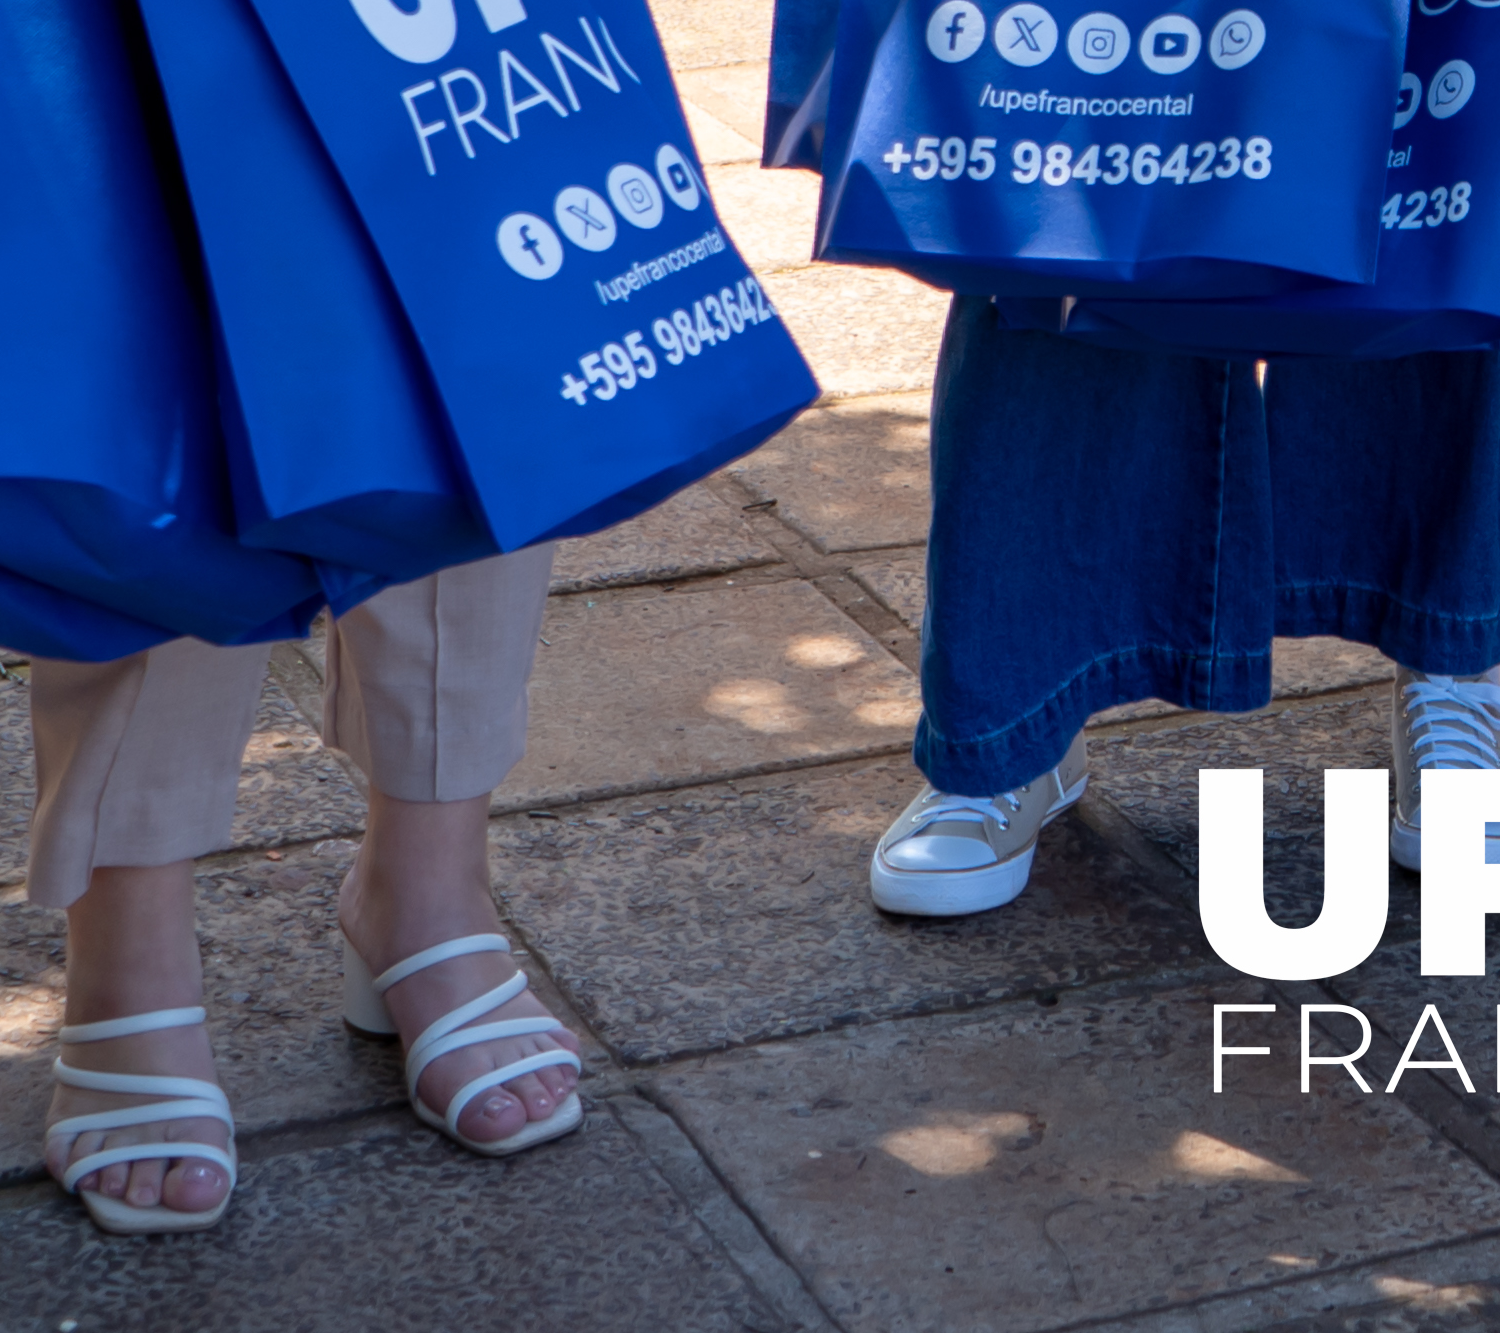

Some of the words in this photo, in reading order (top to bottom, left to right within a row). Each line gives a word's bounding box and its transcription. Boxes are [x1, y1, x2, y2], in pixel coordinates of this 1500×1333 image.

[979, 84, 1195, 117] /upefrancocental
[883, 137, 998, 182] +595
[1011, 137, 1274, 188] 984364238
[561, 330, 658, 407] +595
[652, 276, 780, 366] 9843642
